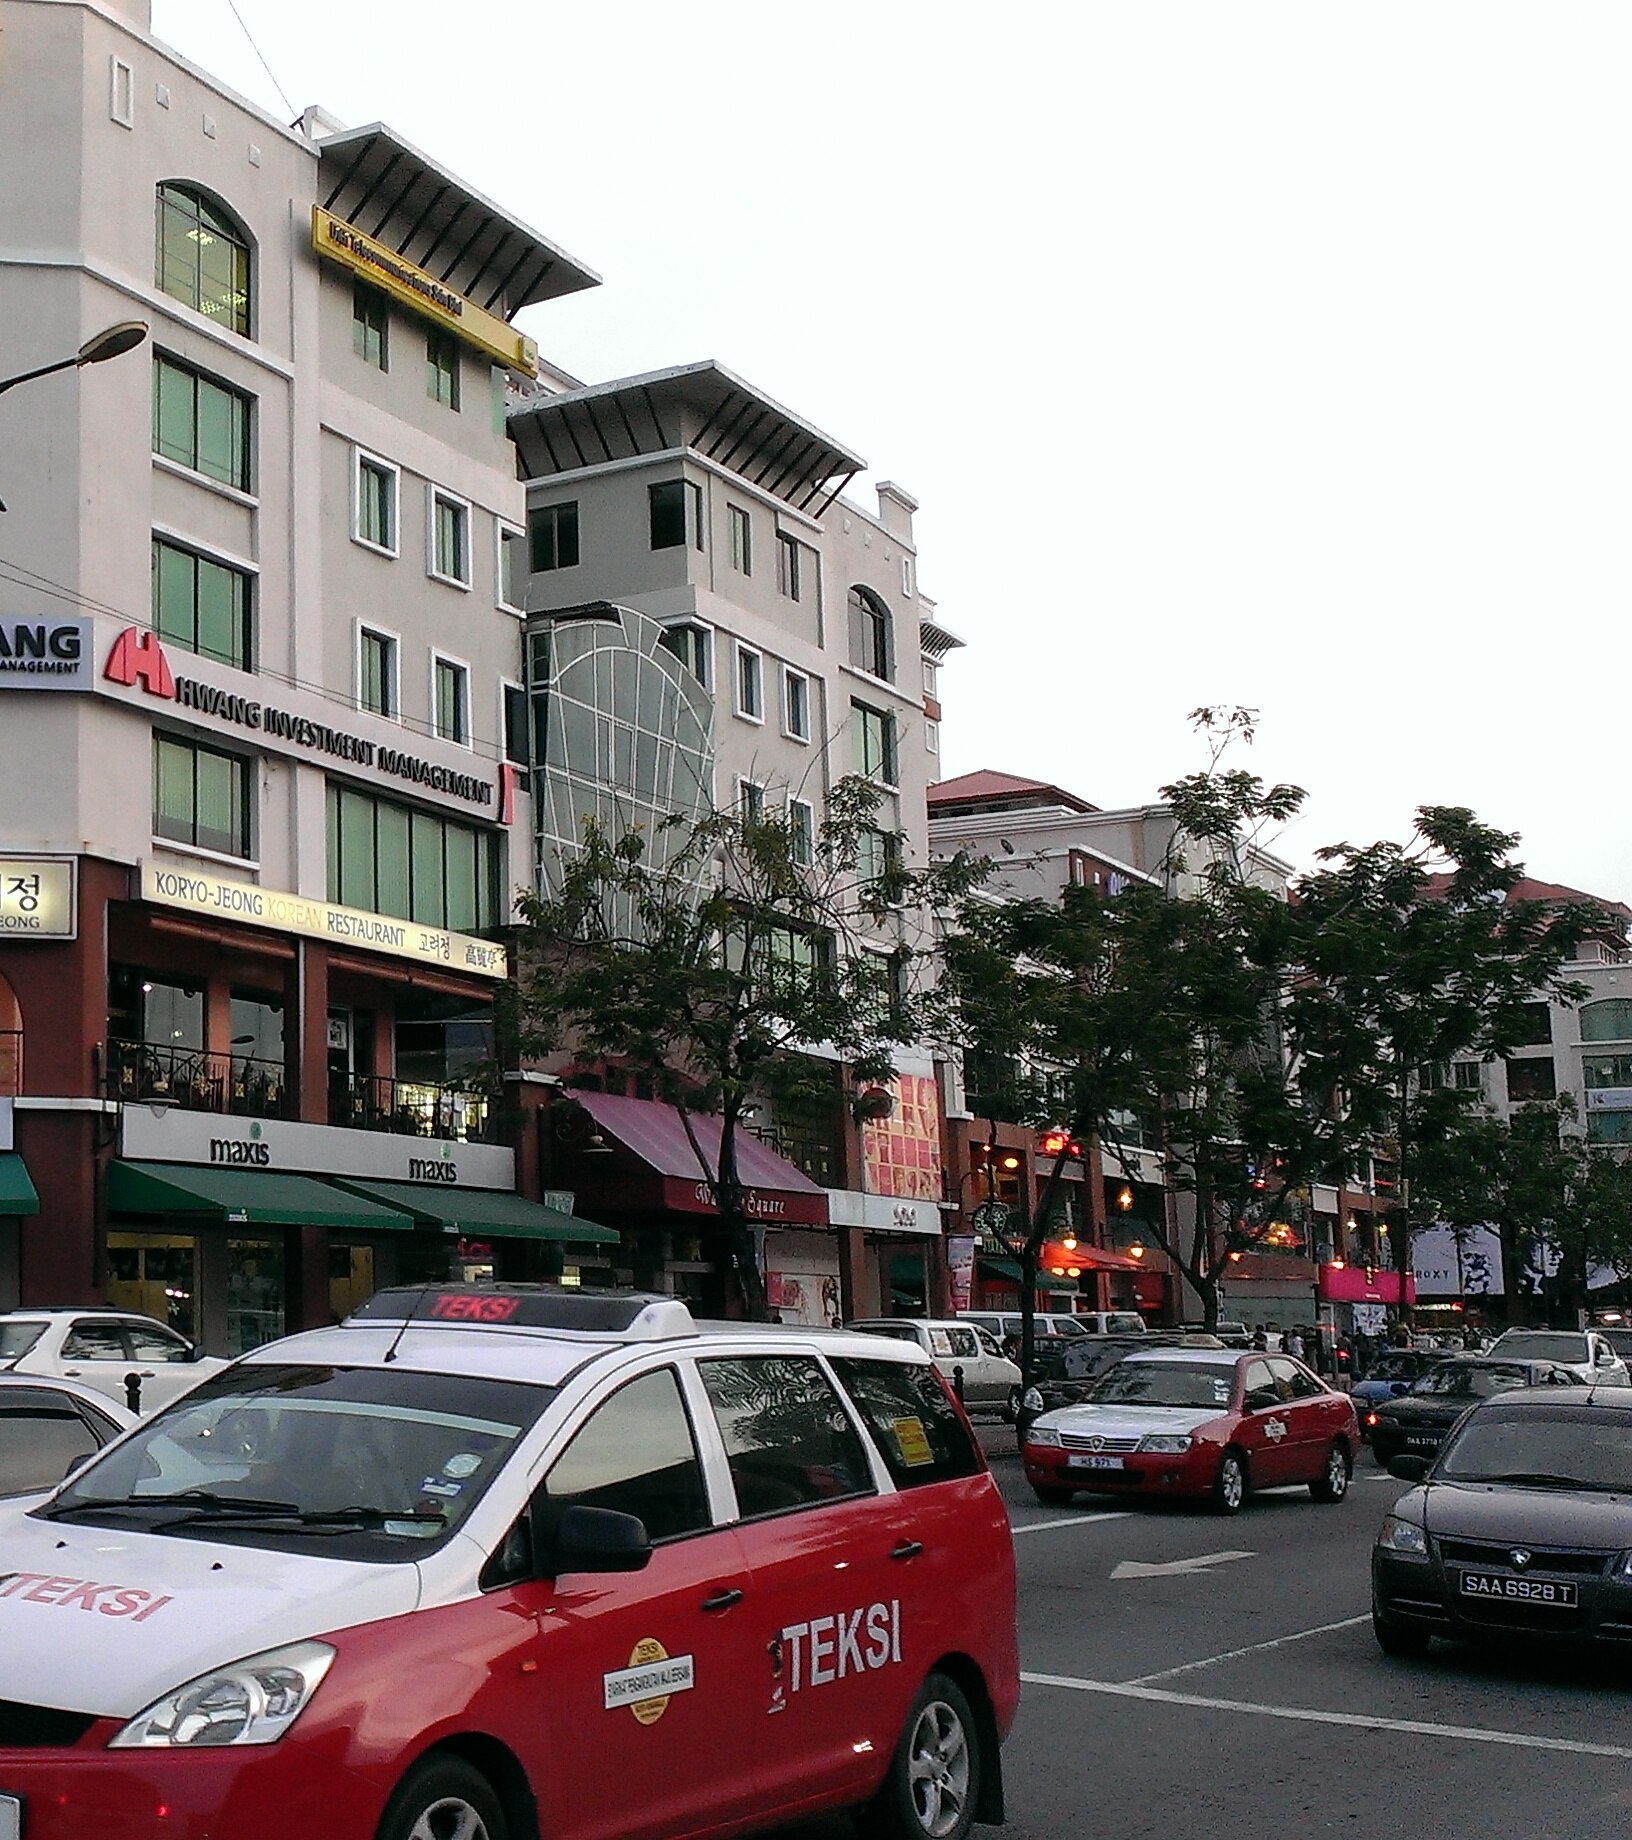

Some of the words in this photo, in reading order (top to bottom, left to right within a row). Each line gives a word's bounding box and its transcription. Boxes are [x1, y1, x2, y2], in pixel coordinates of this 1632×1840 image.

[175, 675, 263, 729] HWANG
[264, 706, 377, 766] INVESTMENT
[378, 744, 495, 806] MANAGEMENT
[154, 870, 264, 916] KORYO-JEONG
[267, 897, 322, 930] KOREAN
[327, 910, 407, 948] RESTAURANT
[418, 932, 451, 960] 고려정
[210, 1121, 270, 1166] maxis
[409, 1143, 458, 1182] maxis
[748, 1190, 785, 1218] Square
[1415, 1269, 1450, 1280] ROXY
[431, 1294, 521, 1320] TEKSI
